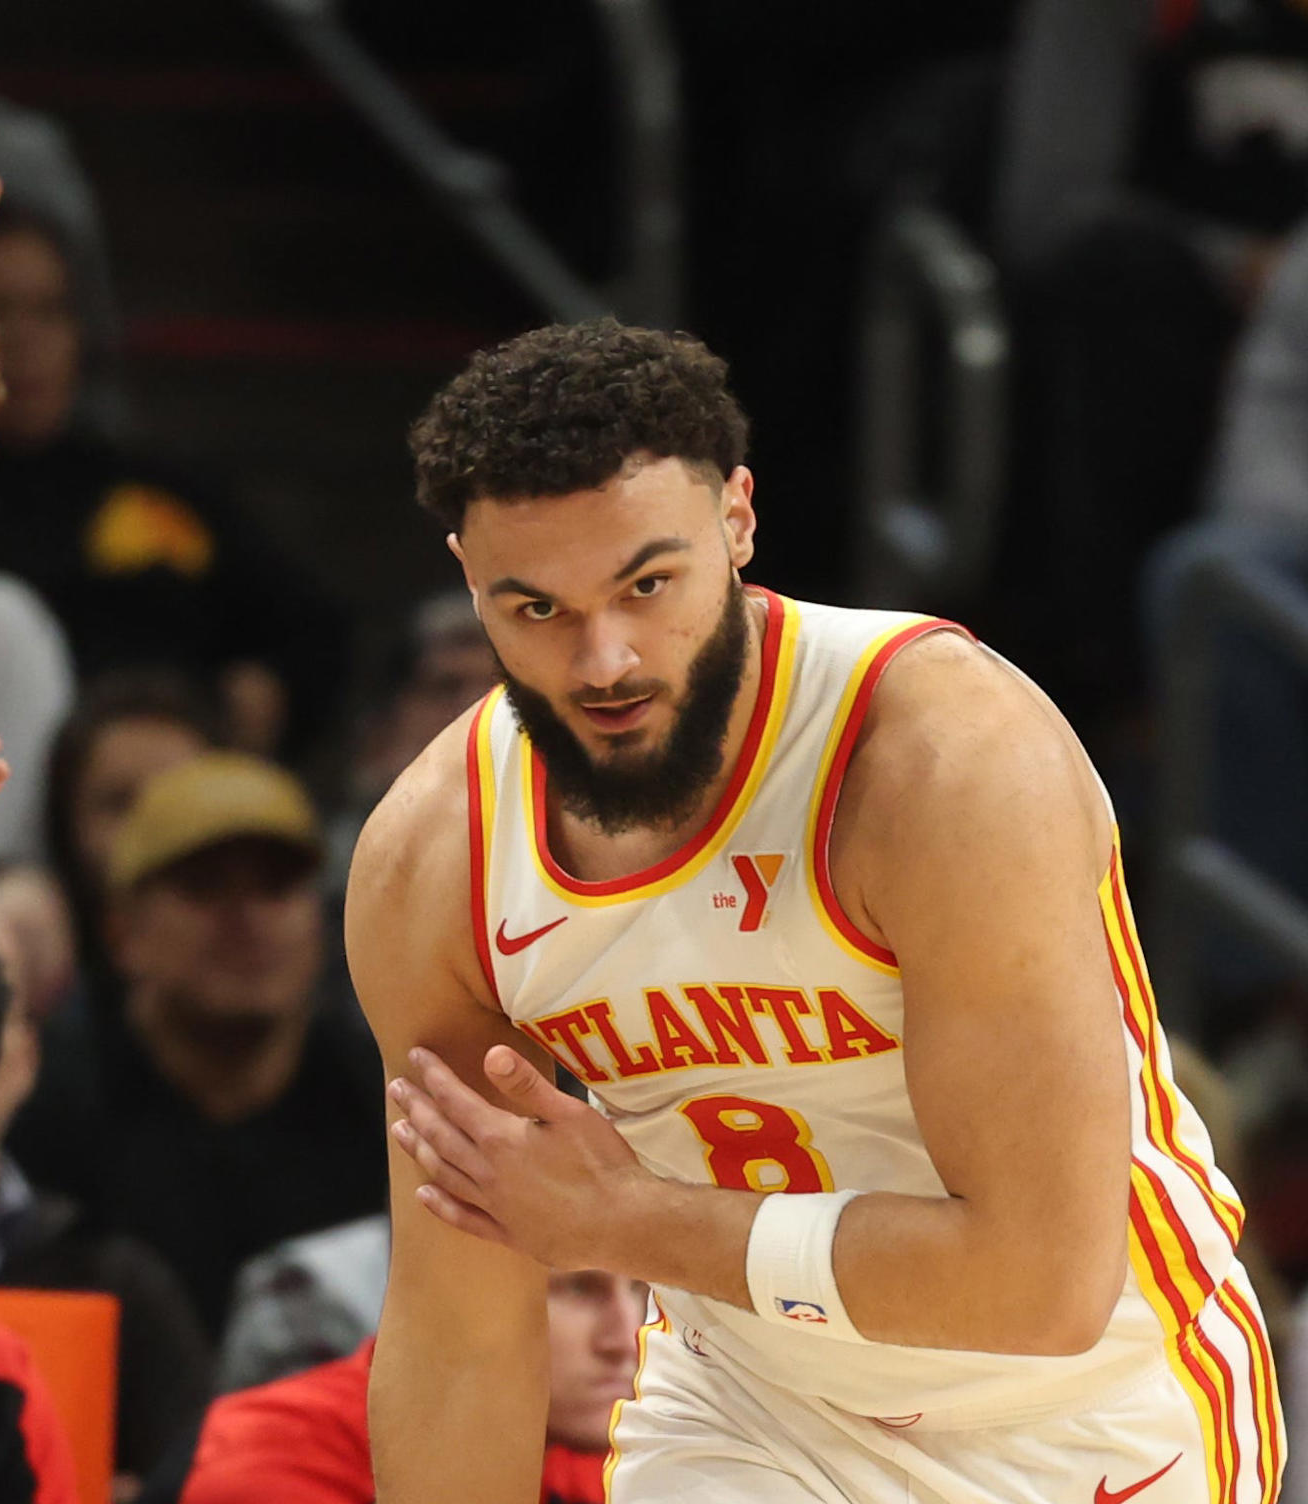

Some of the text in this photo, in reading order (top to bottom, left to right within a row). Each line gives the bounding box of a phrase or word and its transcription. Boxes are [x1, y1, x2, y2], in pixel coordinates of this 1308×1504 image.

[713, 893, 736, 908] the
[514, 983, 902, 1083] TLANTA
[675, 1092, 835, 1193] 8
